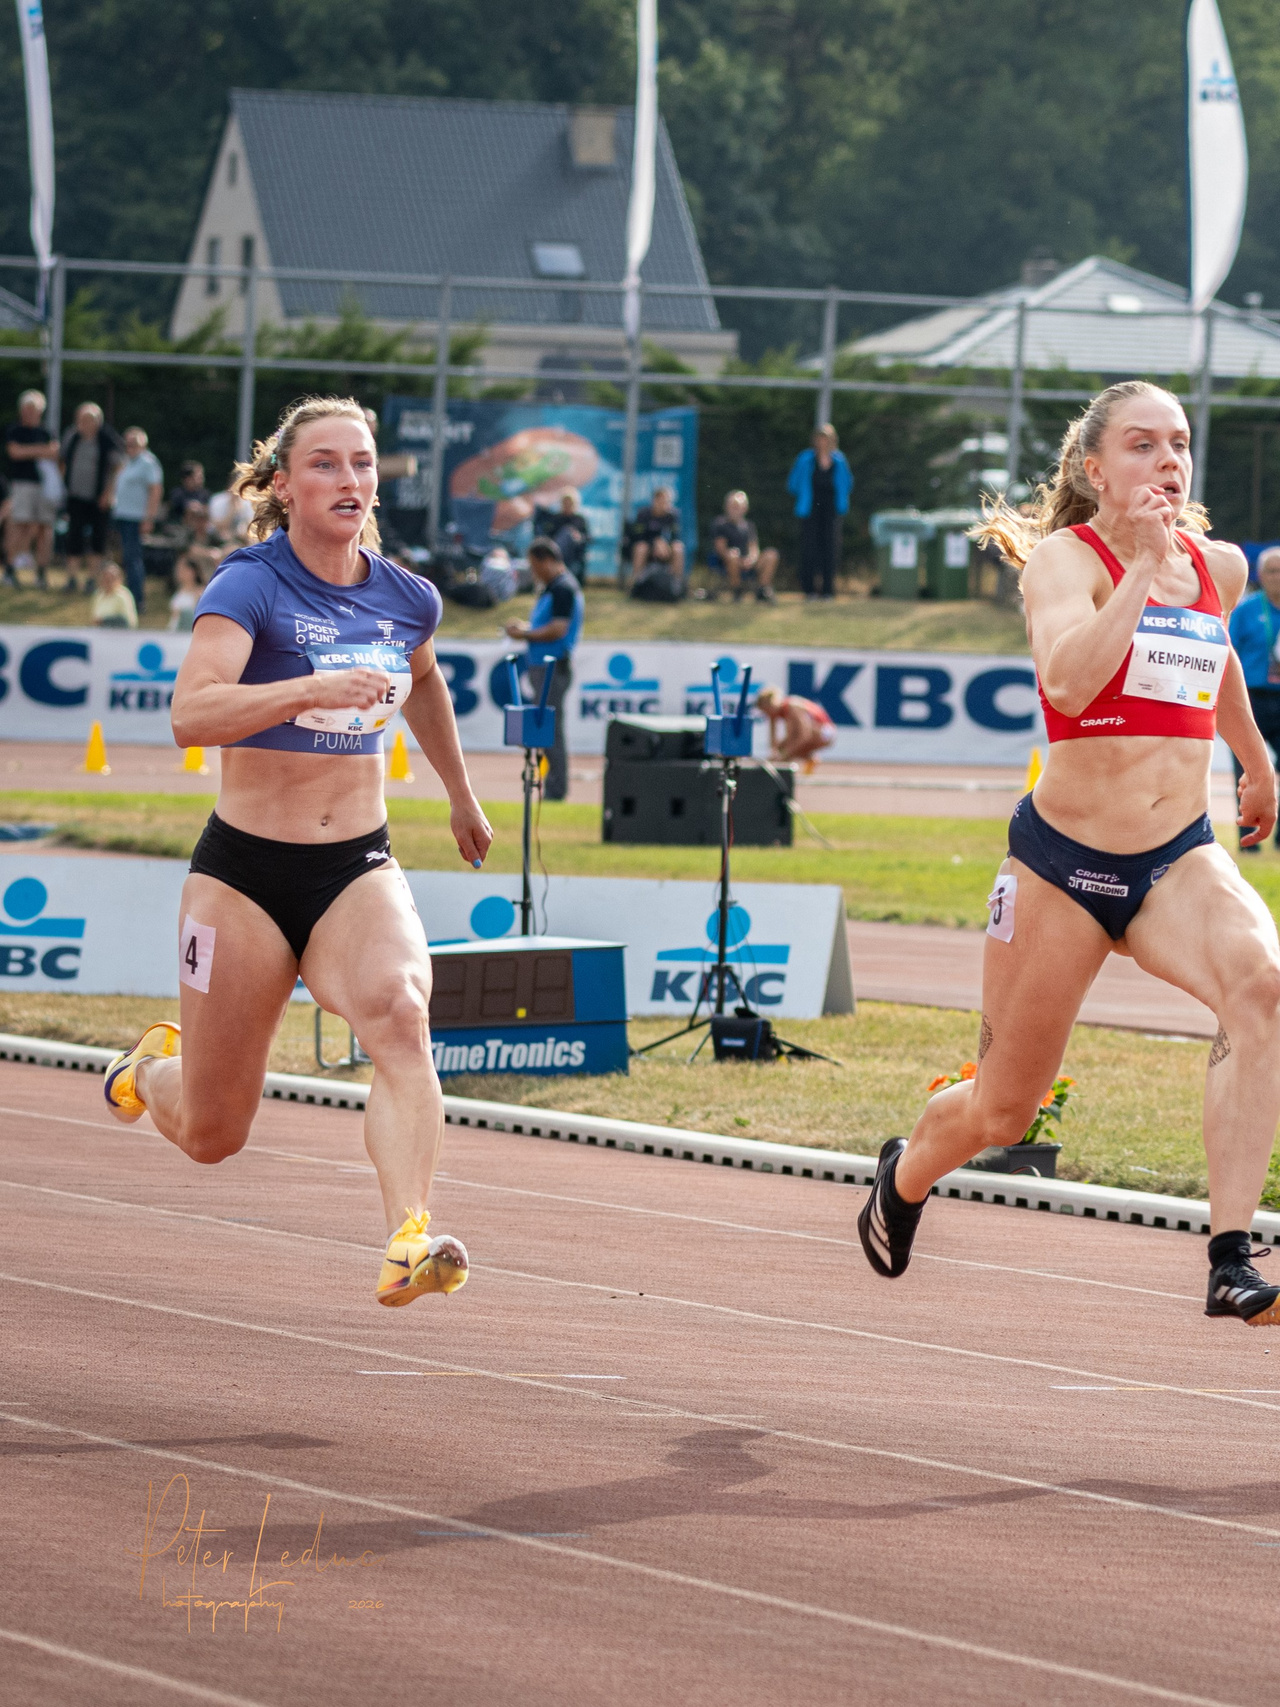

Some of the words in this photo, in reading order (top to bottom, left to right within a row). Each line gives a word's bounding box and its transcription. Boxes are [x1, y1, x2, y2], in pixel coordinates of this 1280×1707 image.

[307, 623, 340, 636] POETS
[309, 632, 336, 644] PUNT
[1147, 650, 1216, 673] KEMPPINEN
[788, 661, 1036, 732] KBC
[580, 697, 659, 718] KBC
[1080, 717, 1116, 727] CRAFT
[313, 732, 363, 750] PUMA
[1075, 868, 1111, 881] CRAFT
[1085, 882, 1126, 896] J-TRADING
[185, 935, 198, 974] 4
[650, 970, 787, 1005] KBC
